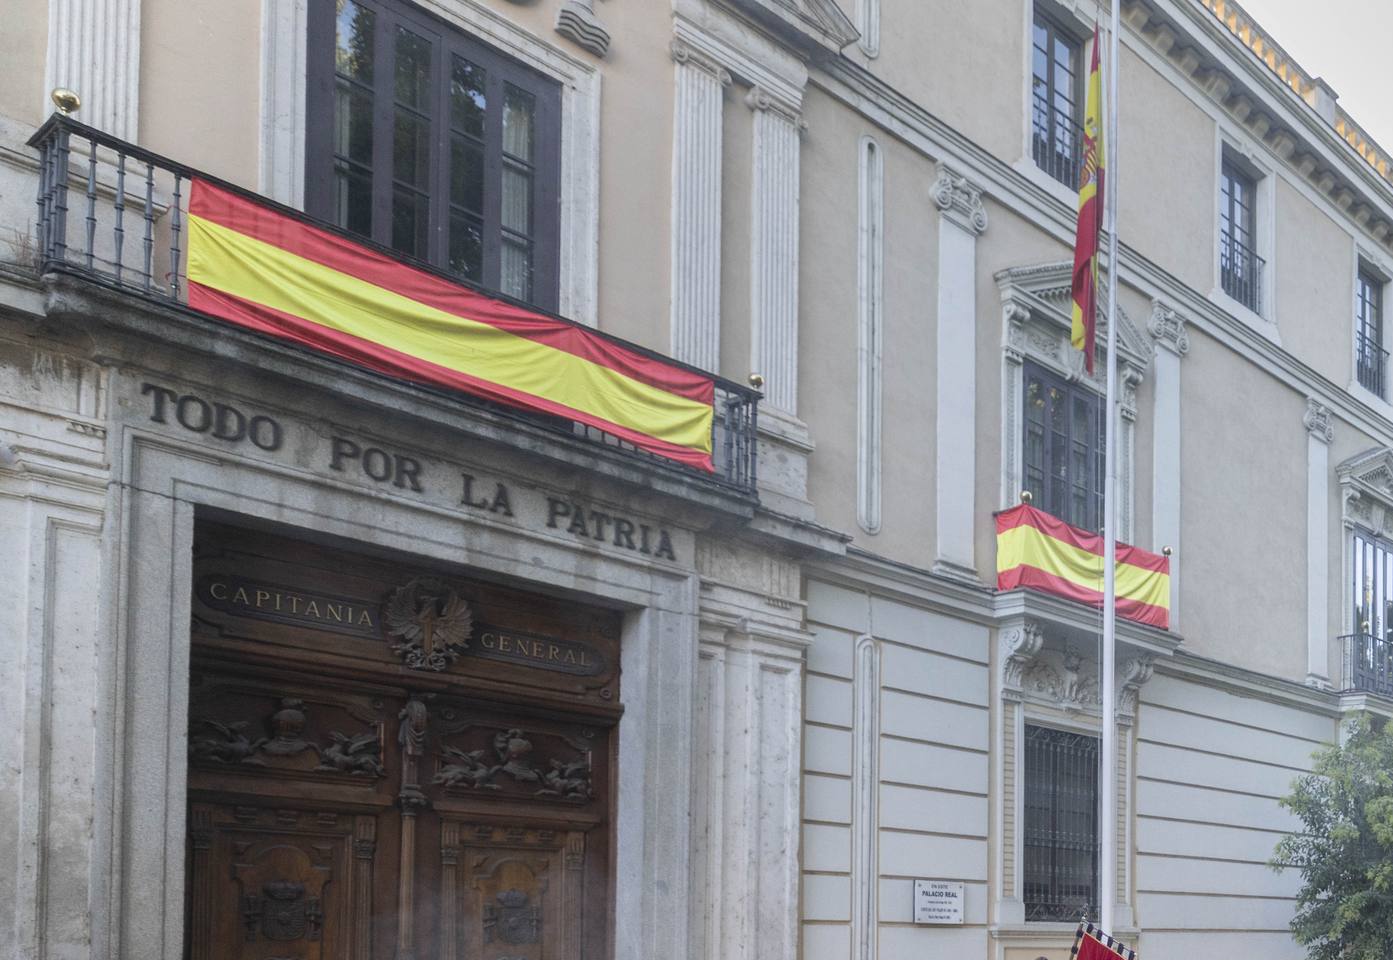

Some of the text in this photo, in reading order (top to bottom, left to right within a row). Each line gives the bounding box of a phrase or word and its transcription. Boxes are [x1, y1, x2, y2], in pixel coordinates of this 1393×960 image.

[141, 383, 677, 561] TODO POR LA PATRIA
[210, 583, 592, 666] CAPITANIA GENERAL
